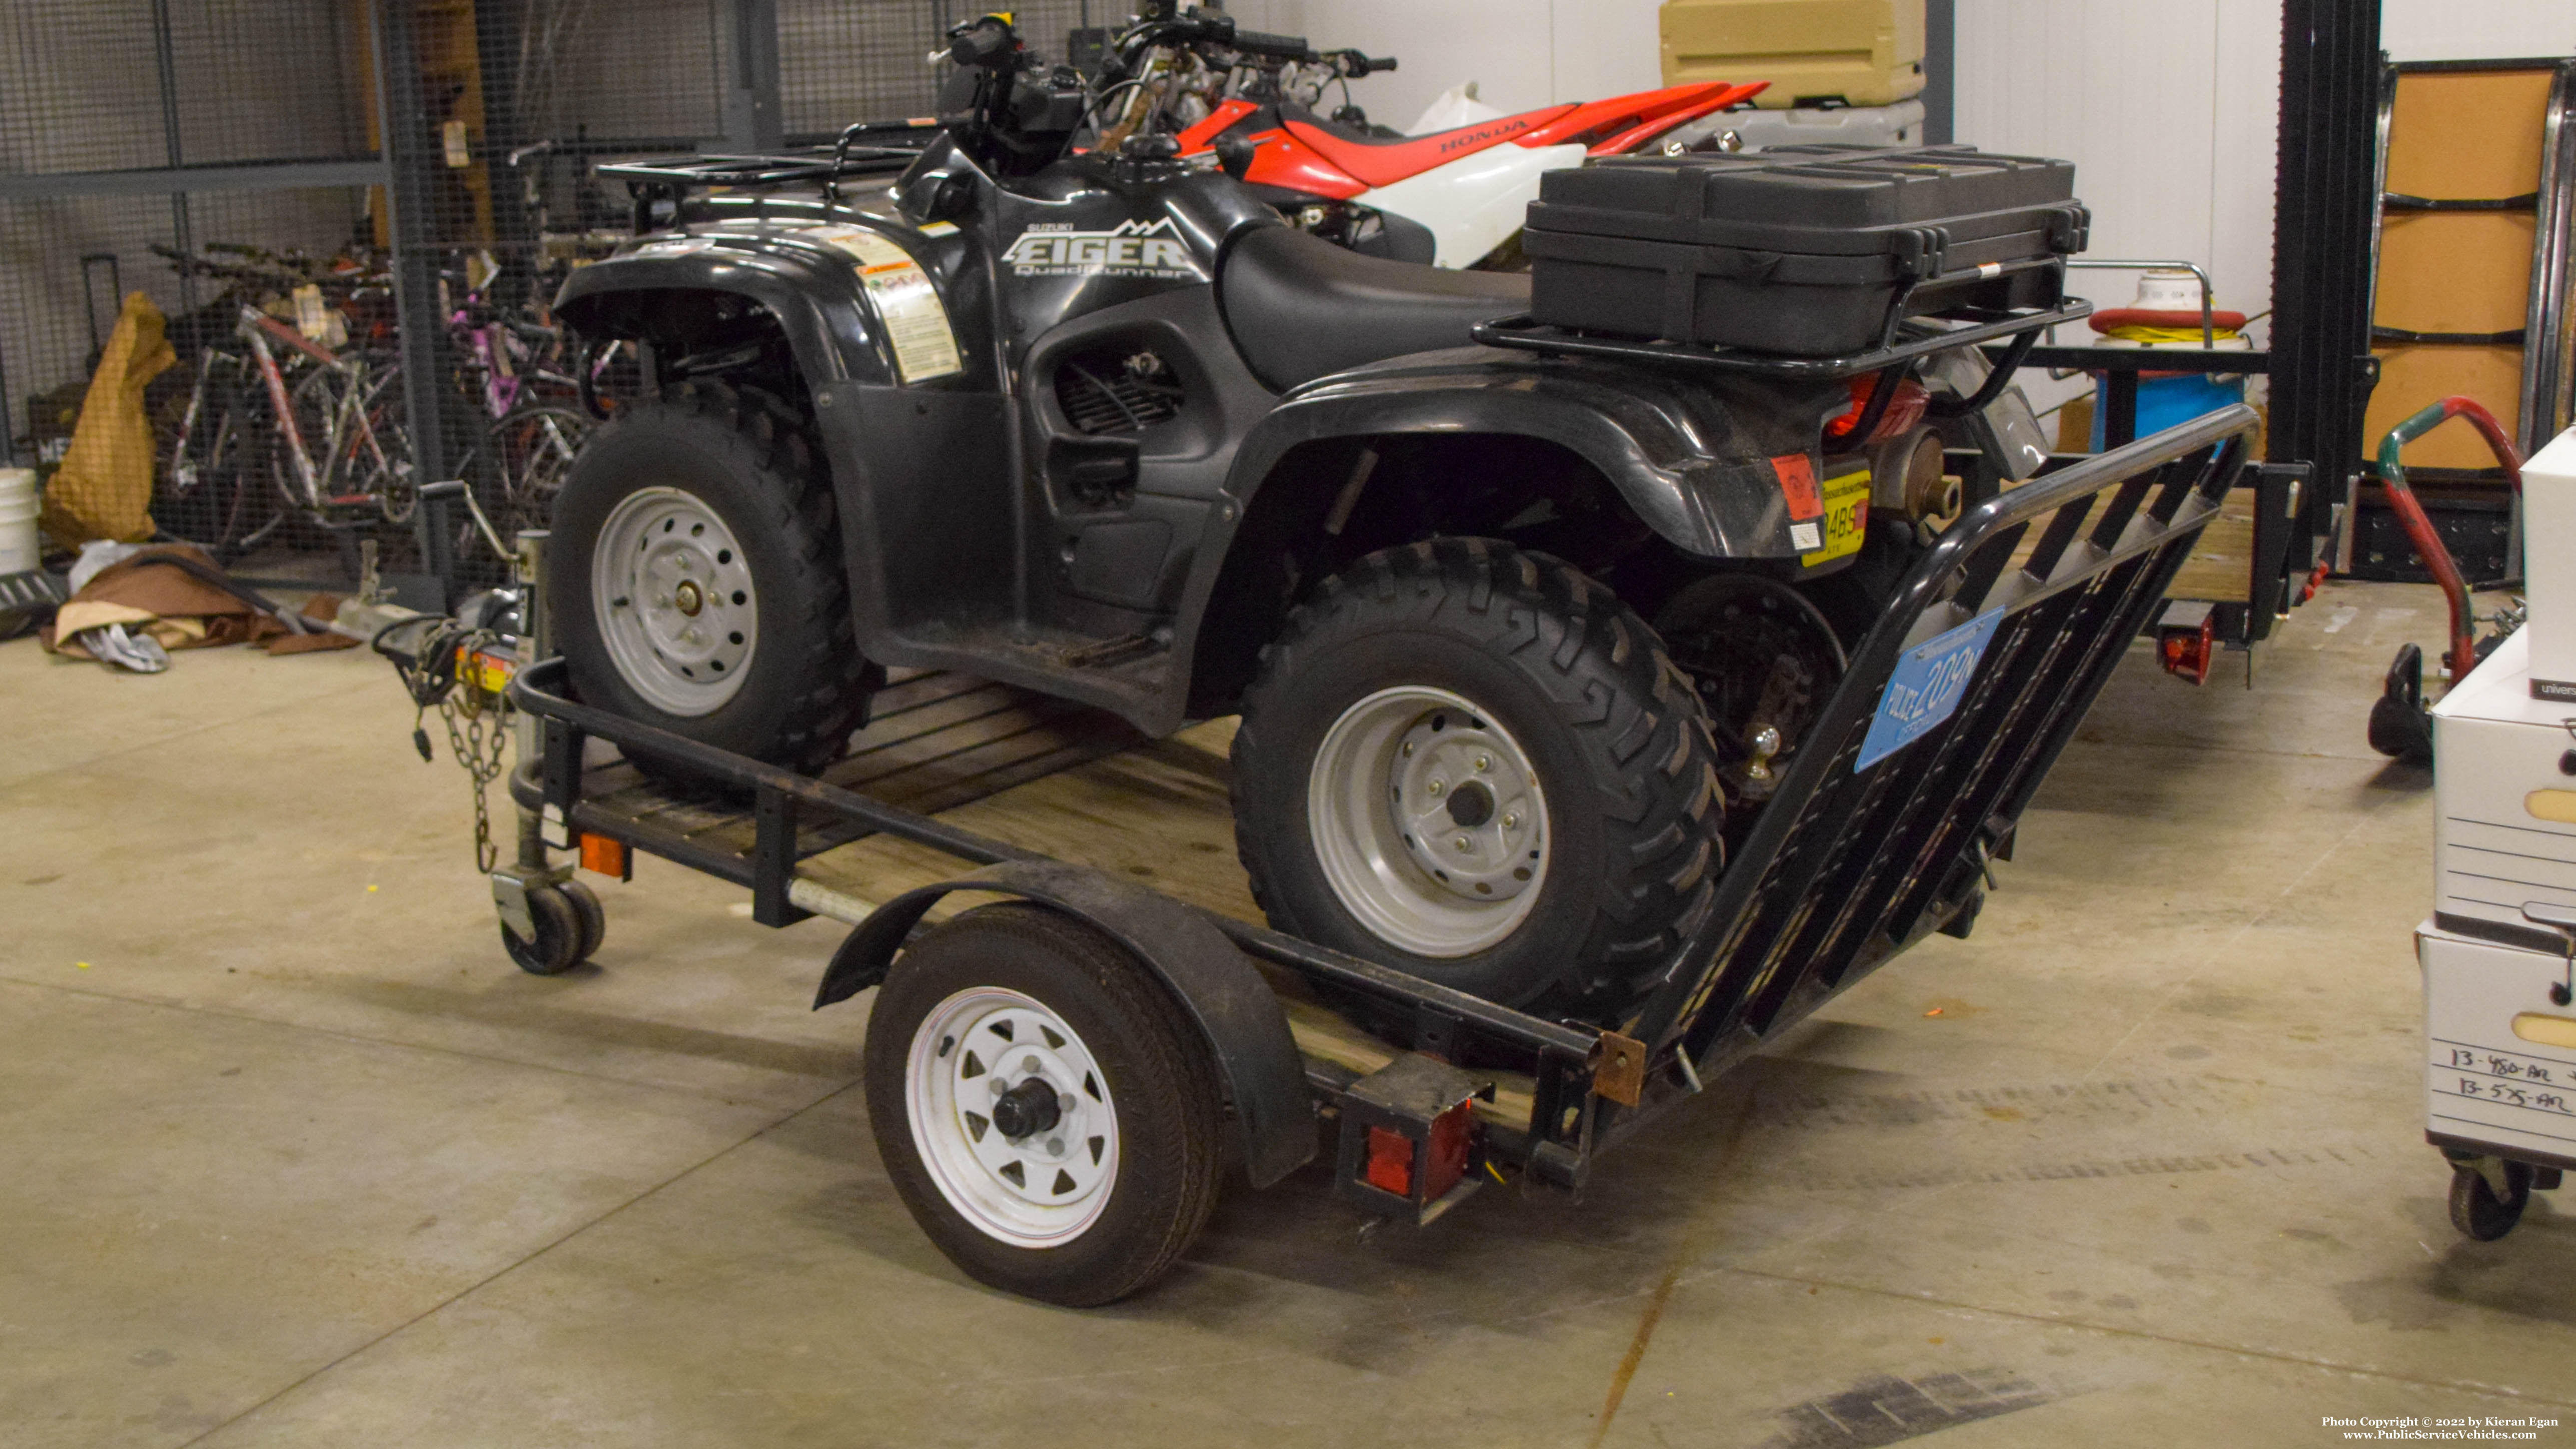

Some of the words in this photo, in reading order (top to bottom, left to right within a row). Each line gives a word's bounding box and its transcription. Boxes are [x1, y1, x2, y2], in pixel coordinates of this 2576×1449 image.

[1441, 120, 1528, 153] HONDA
[1027, 223, 1074, 232] SUZUKI
[1013, 237, 1191, 267] EIGER
